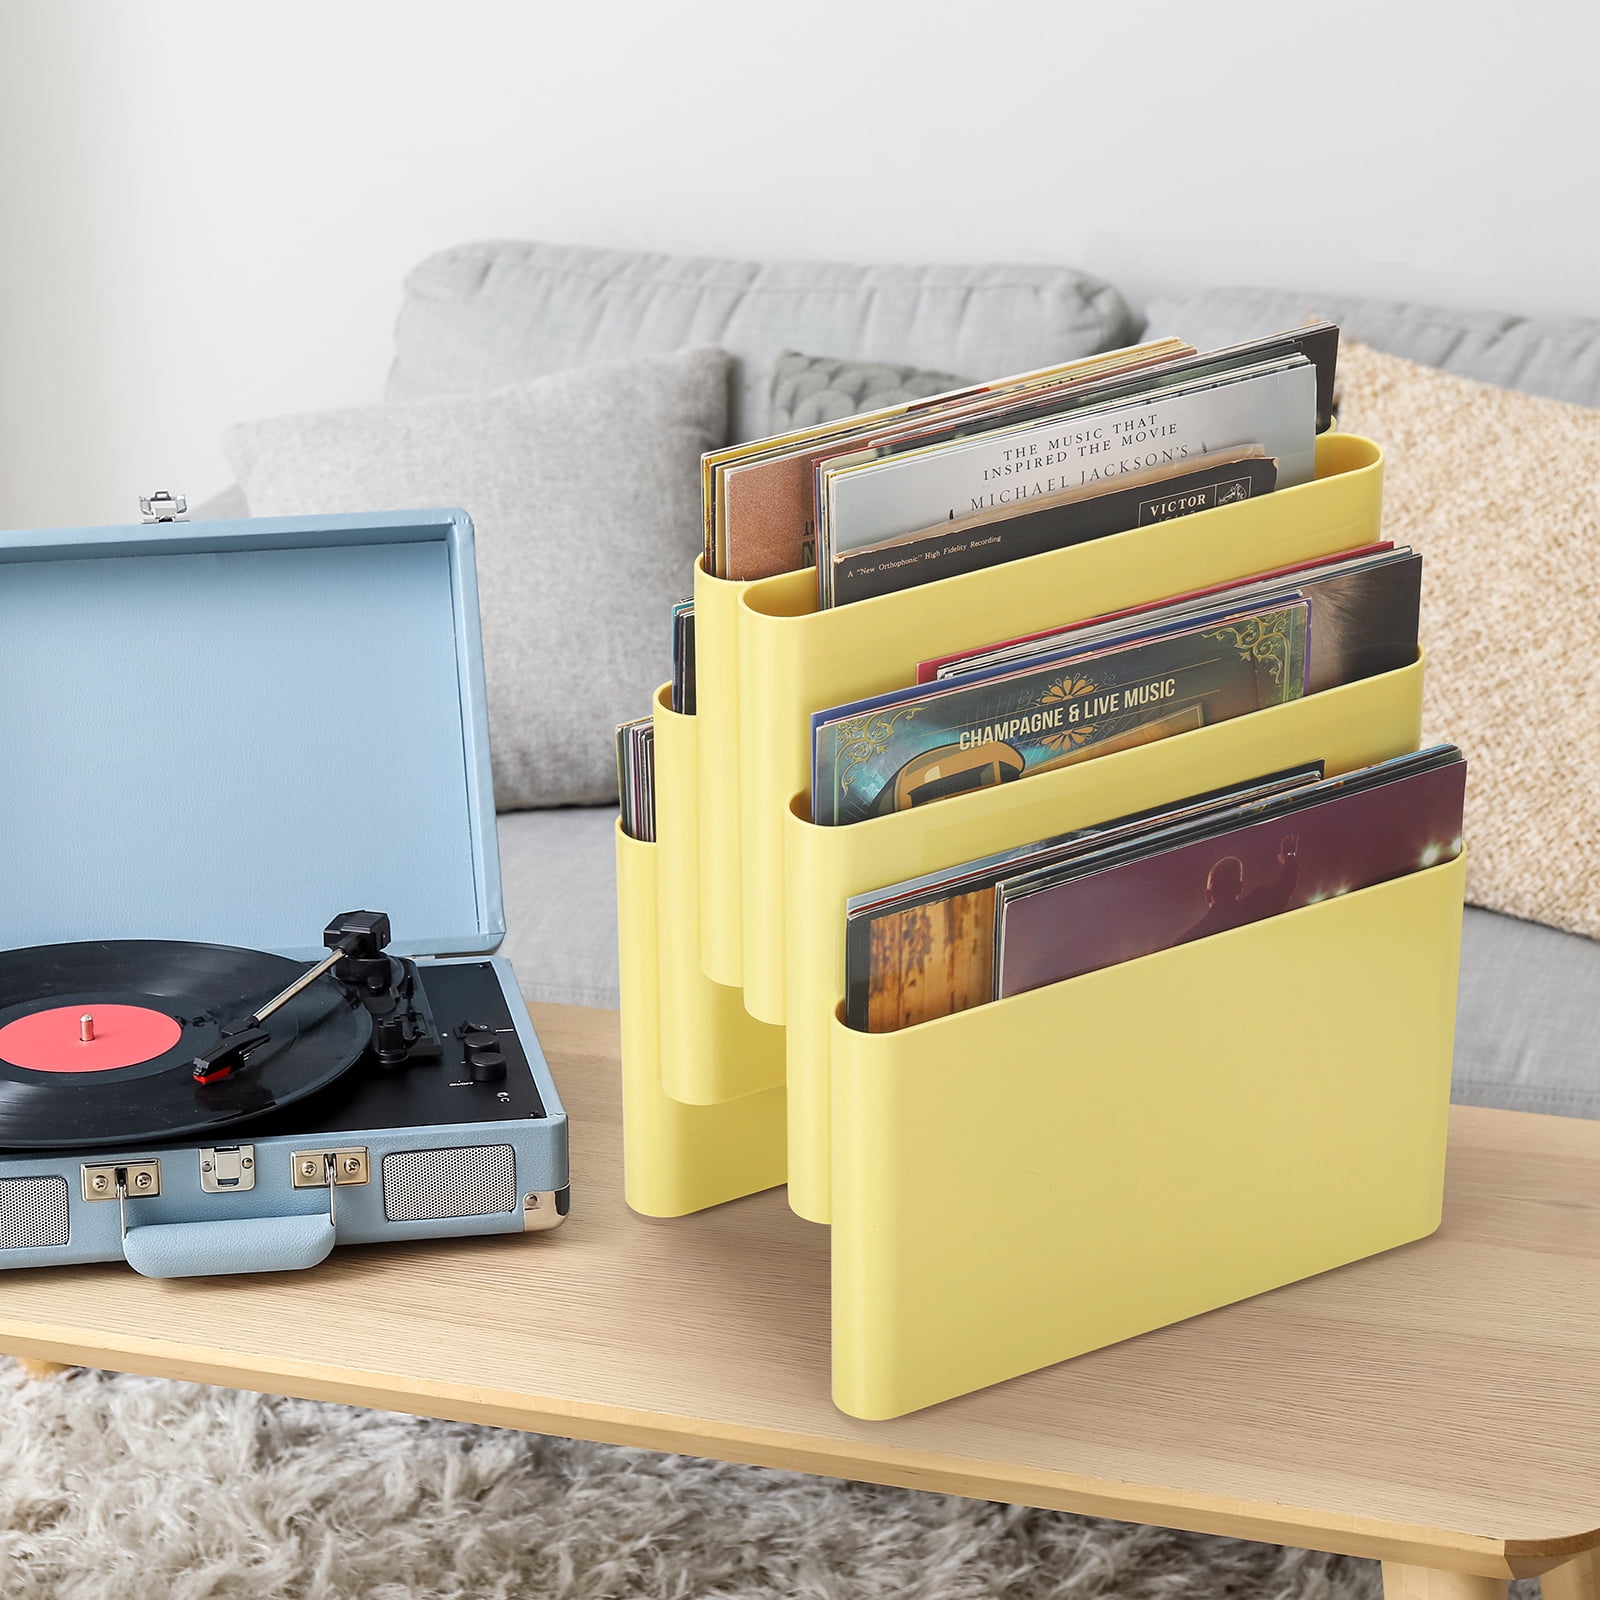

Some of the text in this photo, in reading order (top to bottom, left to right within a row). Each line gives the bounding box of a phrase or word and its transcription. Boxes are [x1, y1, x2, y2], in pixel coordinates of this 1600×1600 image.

[983, 423, 1178, 481] INSPIRED THE MOVIE
[1003, 413, 1158, 461] THE MUSIC THAT
[970, 445, 1189, 511] MICHAEL JACKSON'S
[1150, 494, 1206, 516] VICTOR
[924, 551, 941, 562] High
[943, 543, 968, 556] Fidelity
[970, 534, 1002, 550] Recording
[959, 678, 1176, 751] CHAMPAGNE & LIVE MUSIC
